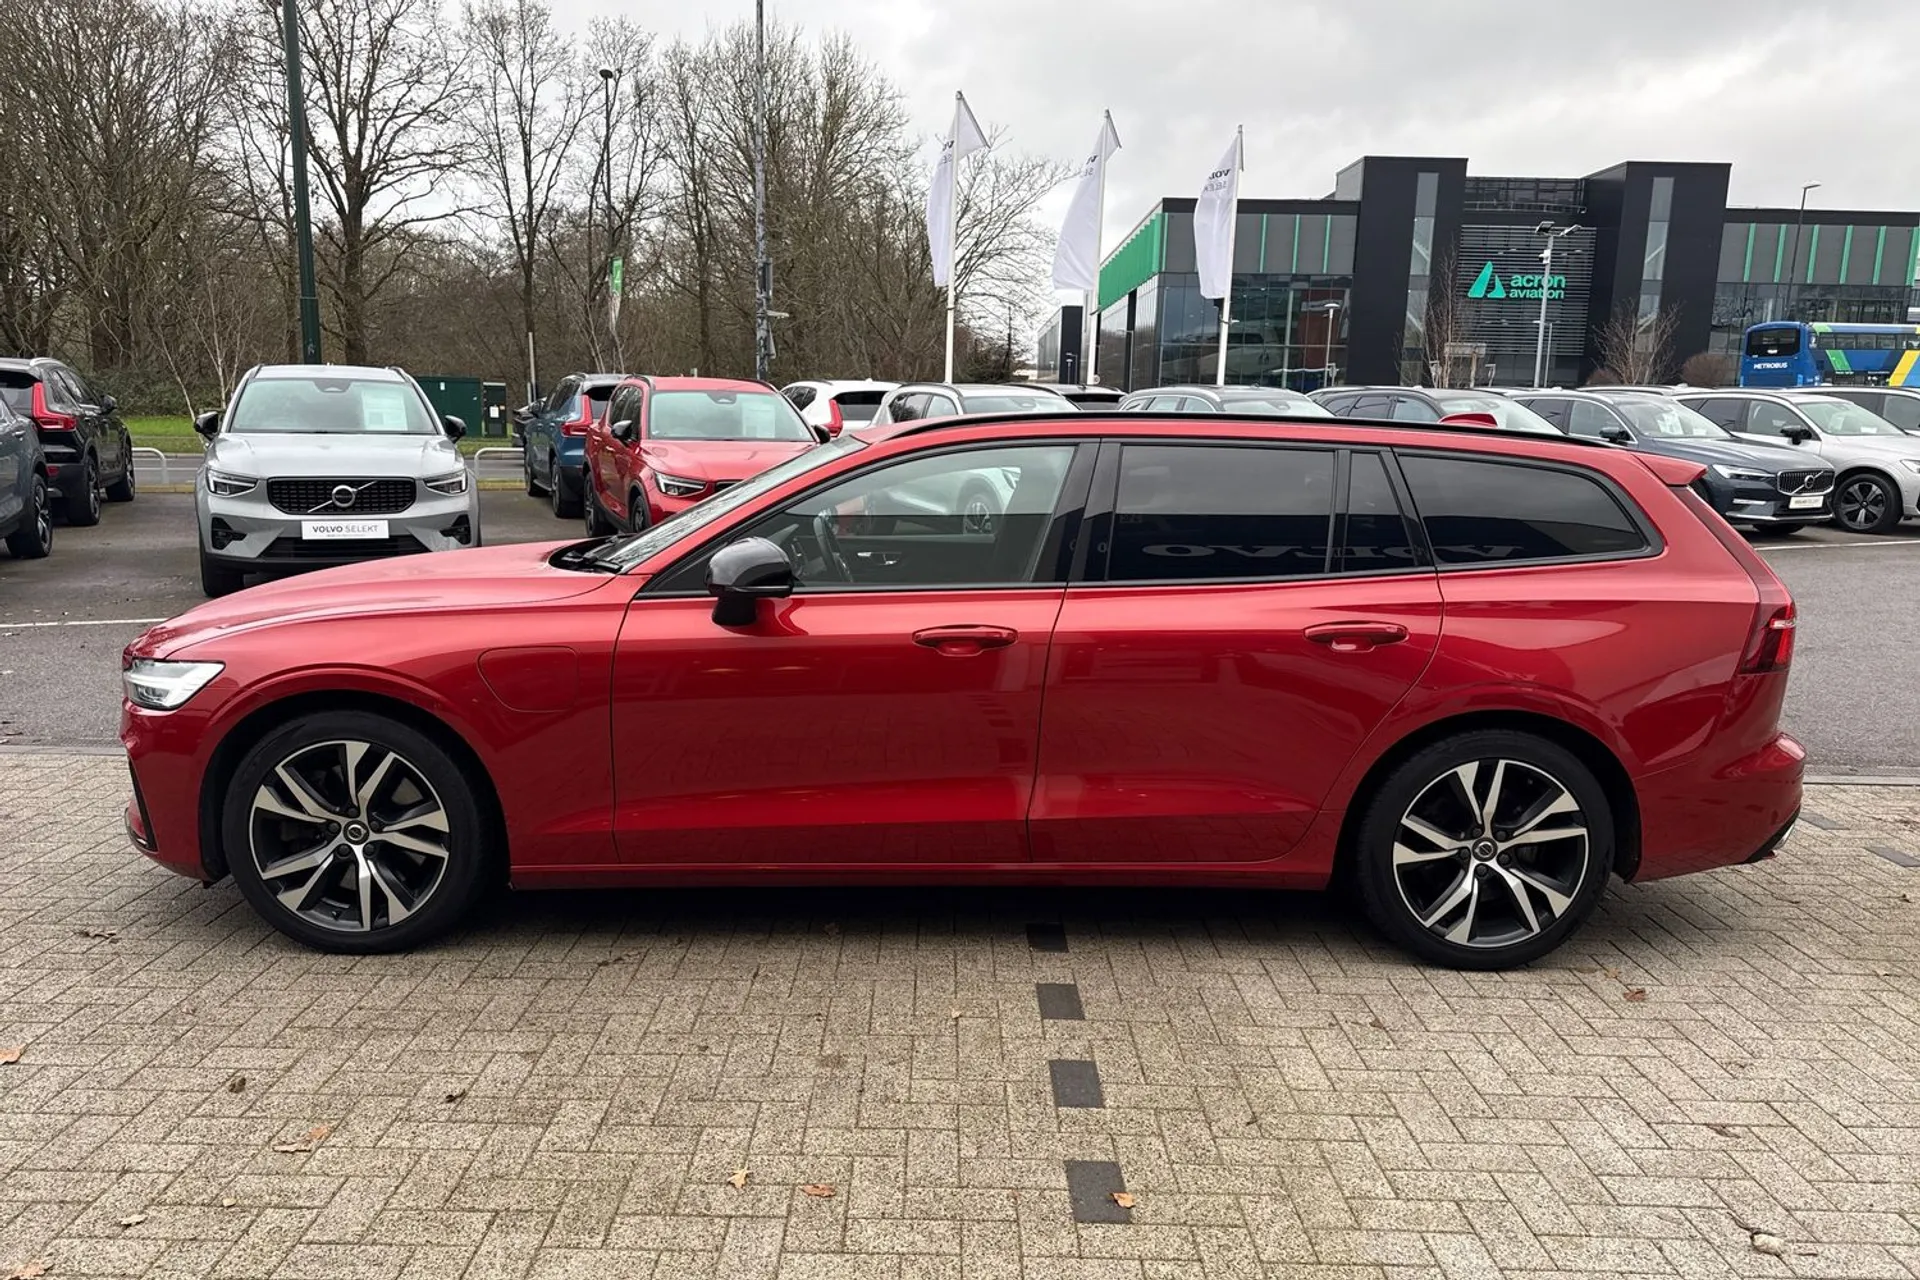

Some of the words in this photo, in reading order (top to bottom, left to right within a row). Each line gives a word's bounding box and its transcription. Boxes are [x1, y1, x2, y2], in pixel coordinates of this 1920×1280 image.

[1509, 288, 1565, 299] aviaton
[1753, 362, 1788, 370] METROBUS
[312, 525, 343, 533] VOLVO
[344, 525, 379, 533] SELEKT
